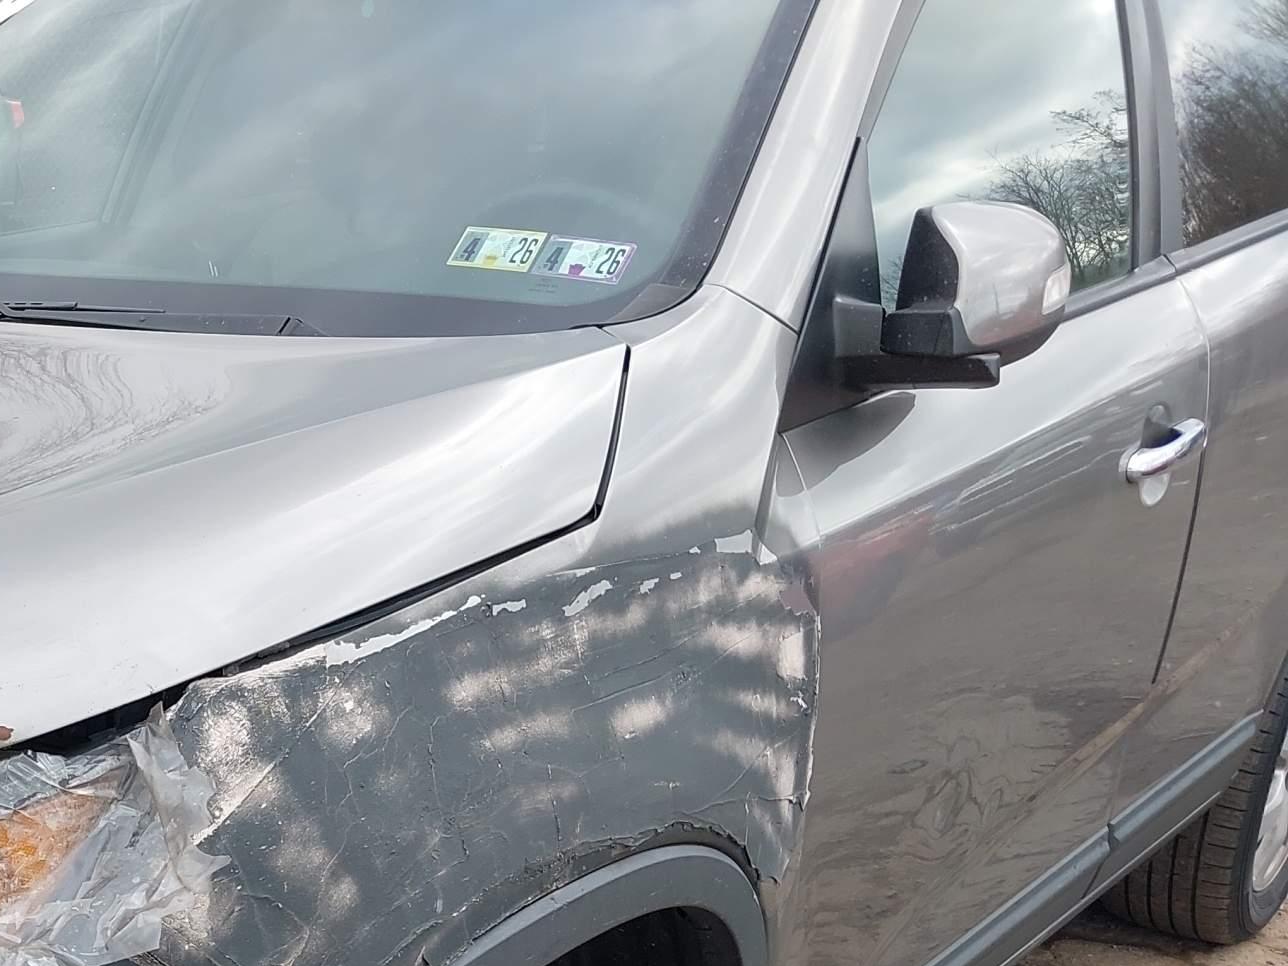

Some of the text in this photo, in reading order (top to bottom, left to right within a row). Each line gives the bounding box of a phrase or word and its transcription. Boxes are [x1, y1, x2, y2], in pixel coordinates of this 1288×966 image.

[462, 237, 481, 262] 4
[509, 236, 540, 265] 26
[545, 246, 565, 272] 4
[595, 246, 626, 276] 26
